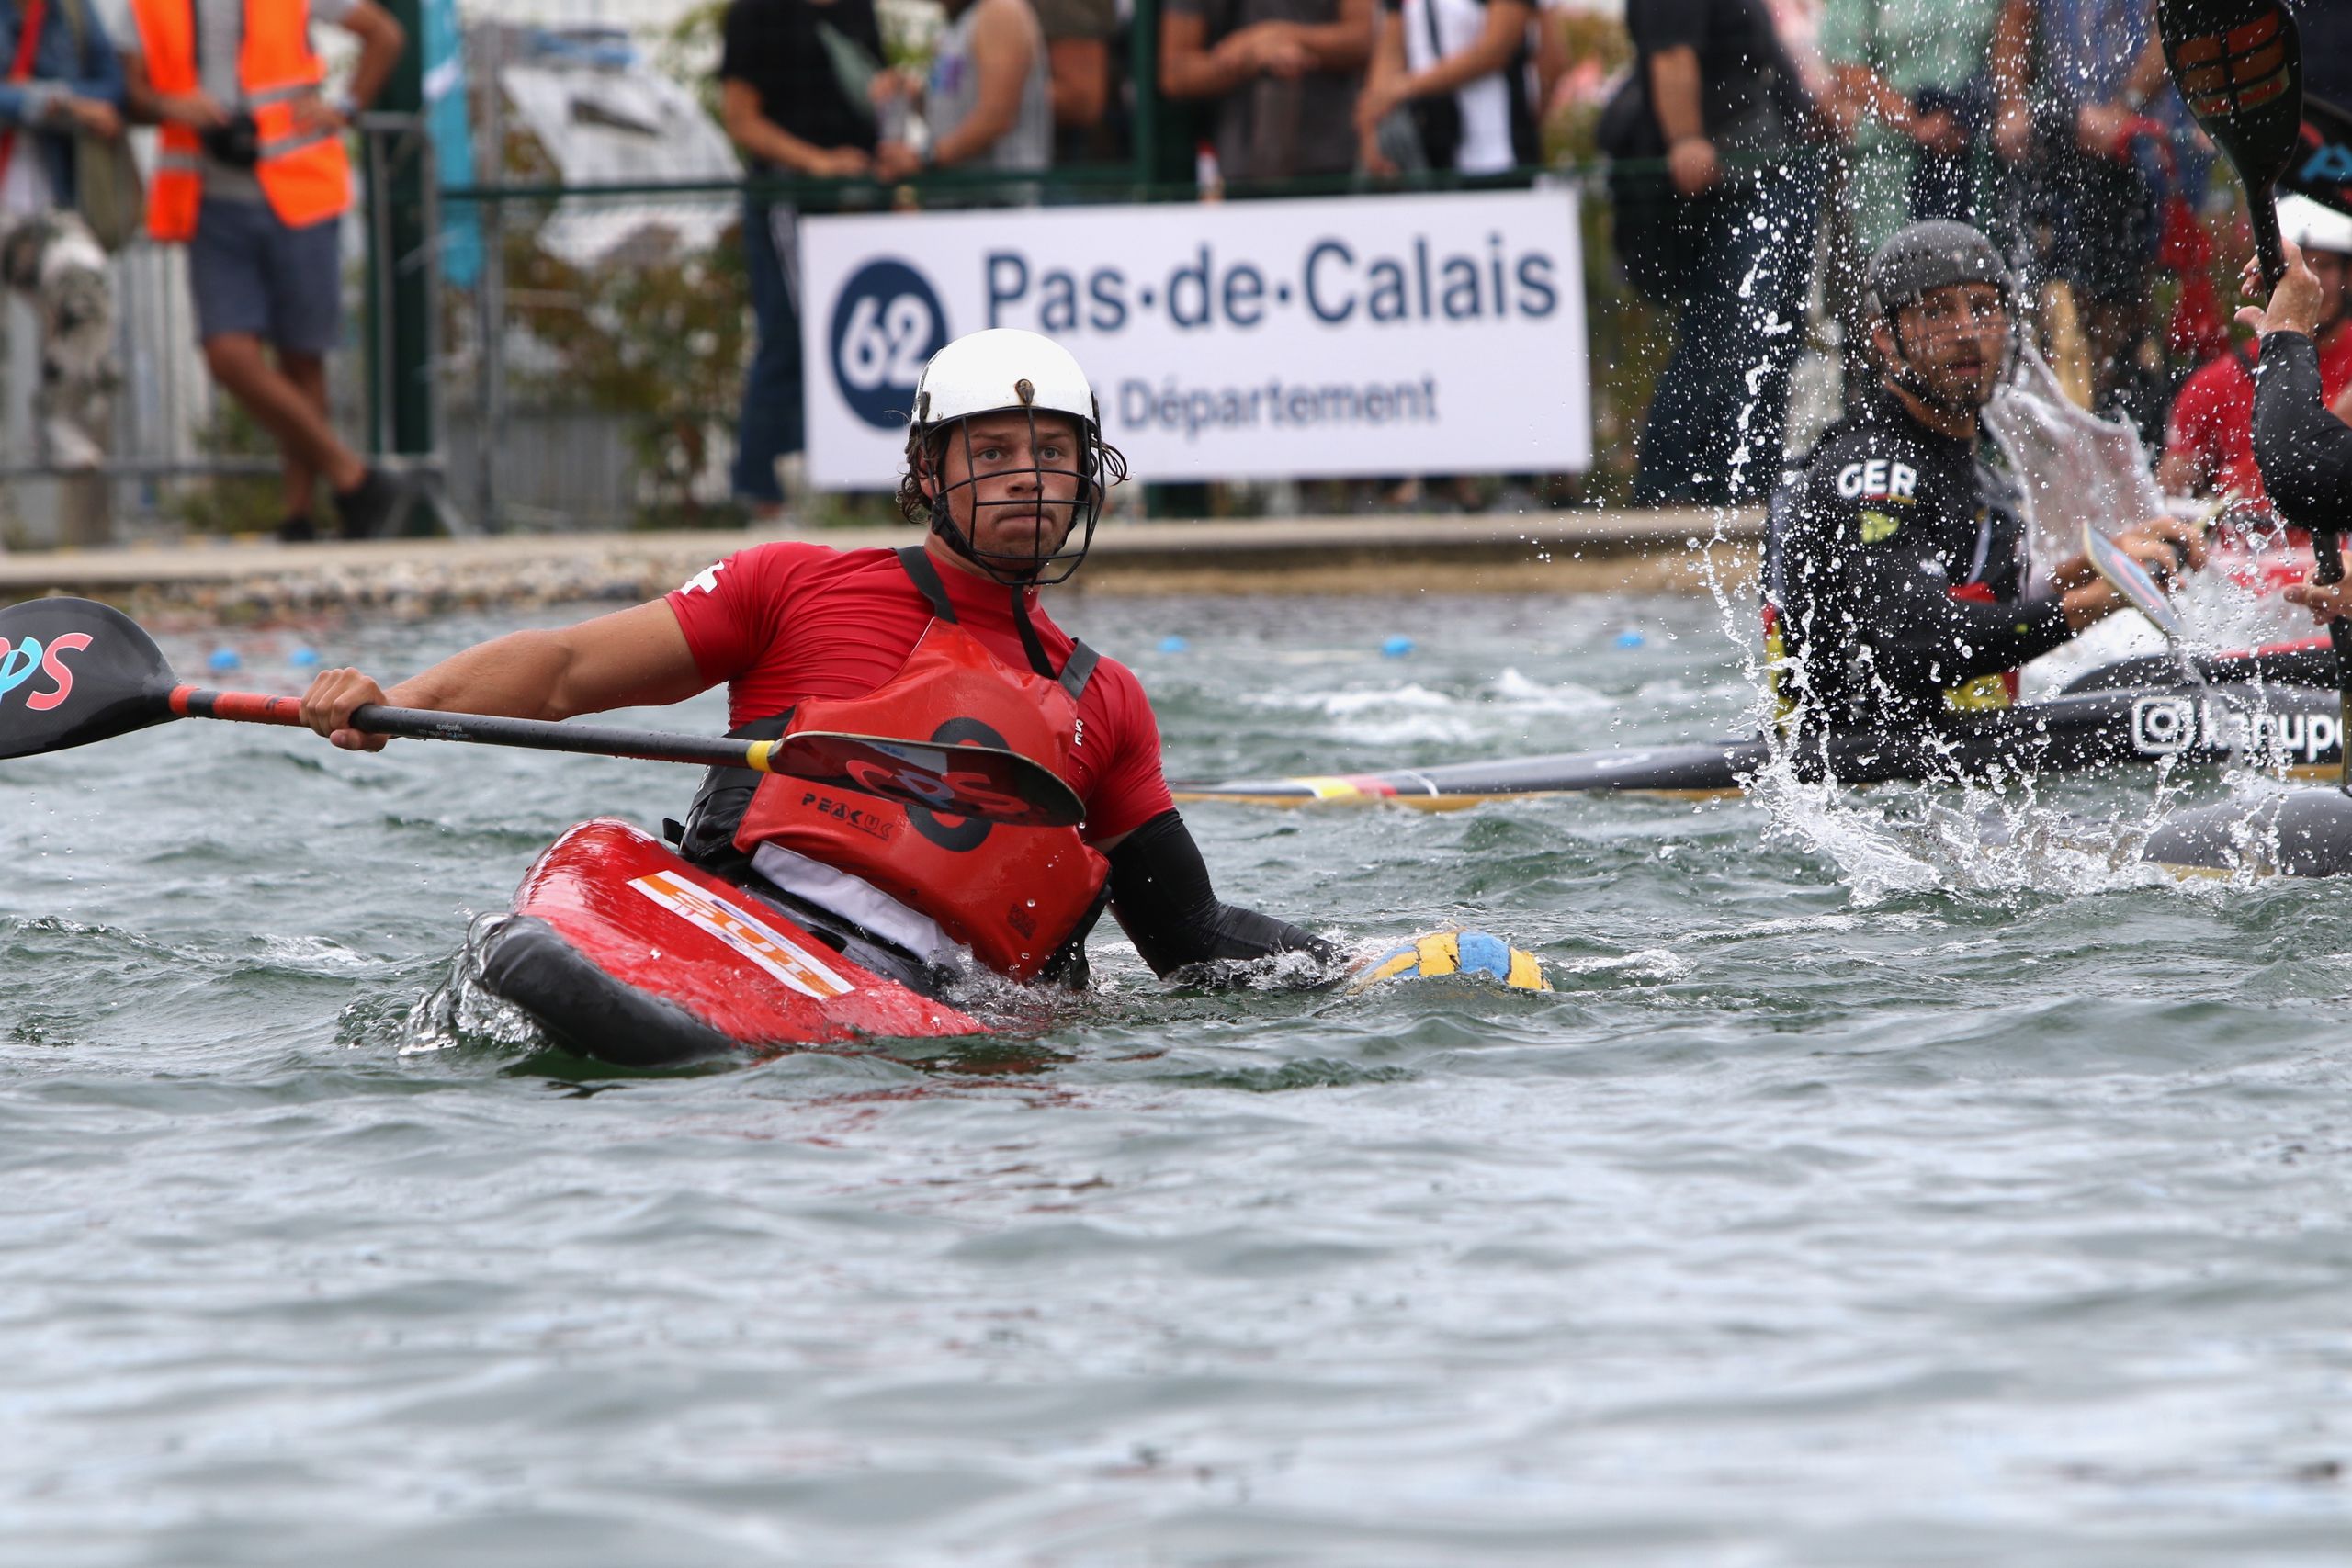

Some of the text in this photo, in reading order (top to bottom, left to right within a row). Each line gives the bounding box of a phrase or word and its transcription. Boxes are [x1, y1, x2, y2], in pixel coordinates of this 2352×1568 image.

[840, 292, 934, 389] 62
[1119, 372, 1438, 437] Département
[1837, 459, 1917, 500] GER
